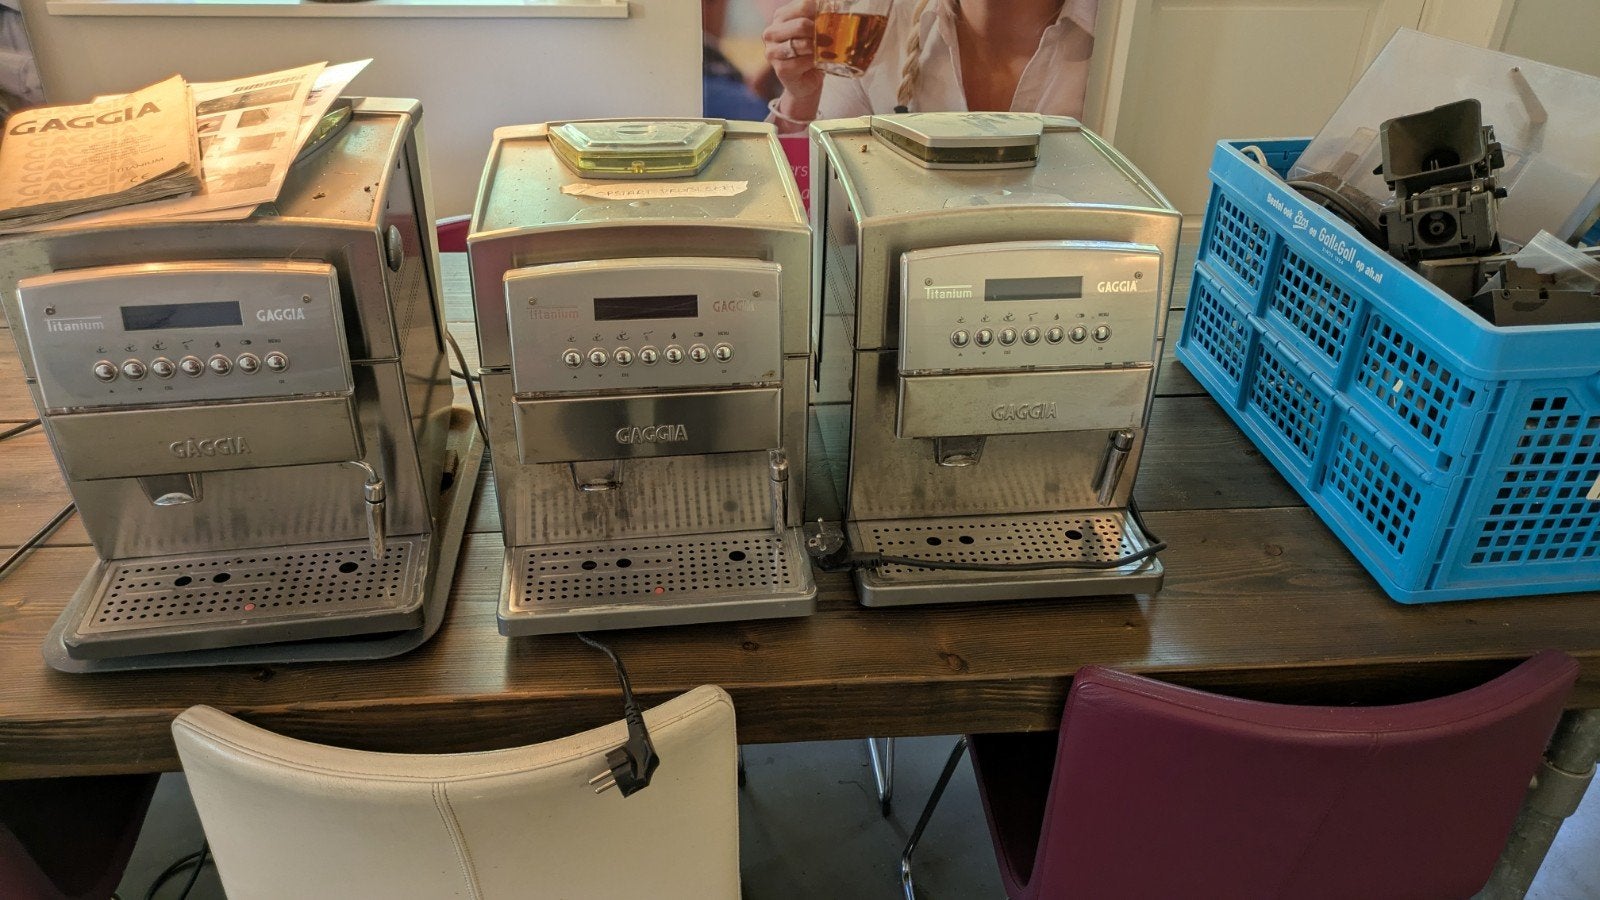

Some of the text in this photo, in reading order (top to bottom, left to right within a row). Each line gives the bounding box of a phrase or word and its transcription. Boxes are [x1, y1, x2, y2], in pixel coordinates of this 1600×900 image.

[10, 102, 161, 136] GAGGIA
[1267, 192, 1284, 213] Bestel
[1283, 207, 1293, 219] ook
[1293, 210, 1309, 229] Etos
[1355, 259, 1365, 273] op
[1365, 266, 1384, 284] ah.nl
[924, 285, 973, 300] Titanium
[1097, 280, 1138, 293] GAGGIA
[256, 307, 305, 322] GAGGIA
[527, 305, 579, 320] Titanium
[44, 315, 104, 334] Titanium
[991, 402, 1057, 421] GAGGIA
[615, 424, 689, 445] GAGGIA
[169, 436, 252, 459] GAGGIA
